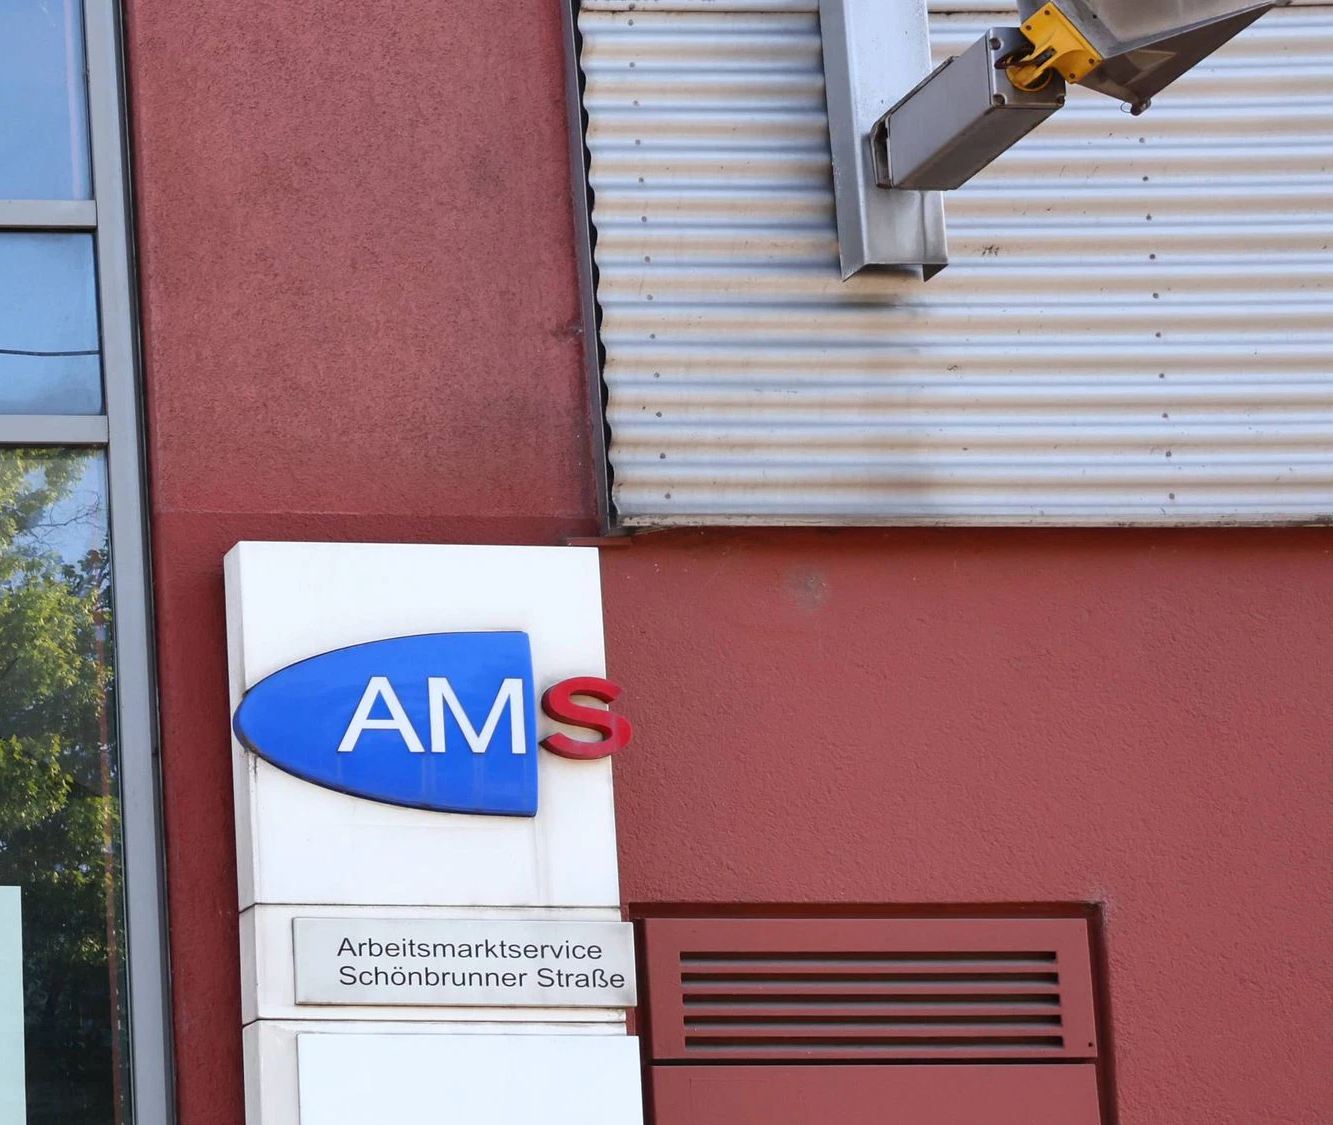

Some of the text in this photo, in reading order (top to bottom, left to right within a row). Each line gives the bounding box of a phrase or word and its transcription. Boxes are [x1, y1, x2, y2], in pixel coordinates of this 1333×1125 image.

[337, 676, 632, 760] AMS
[337, 937, 603, 960] Arbeitsmarktservice
[339, 966, 626, 989] Schönbrunner Straße
